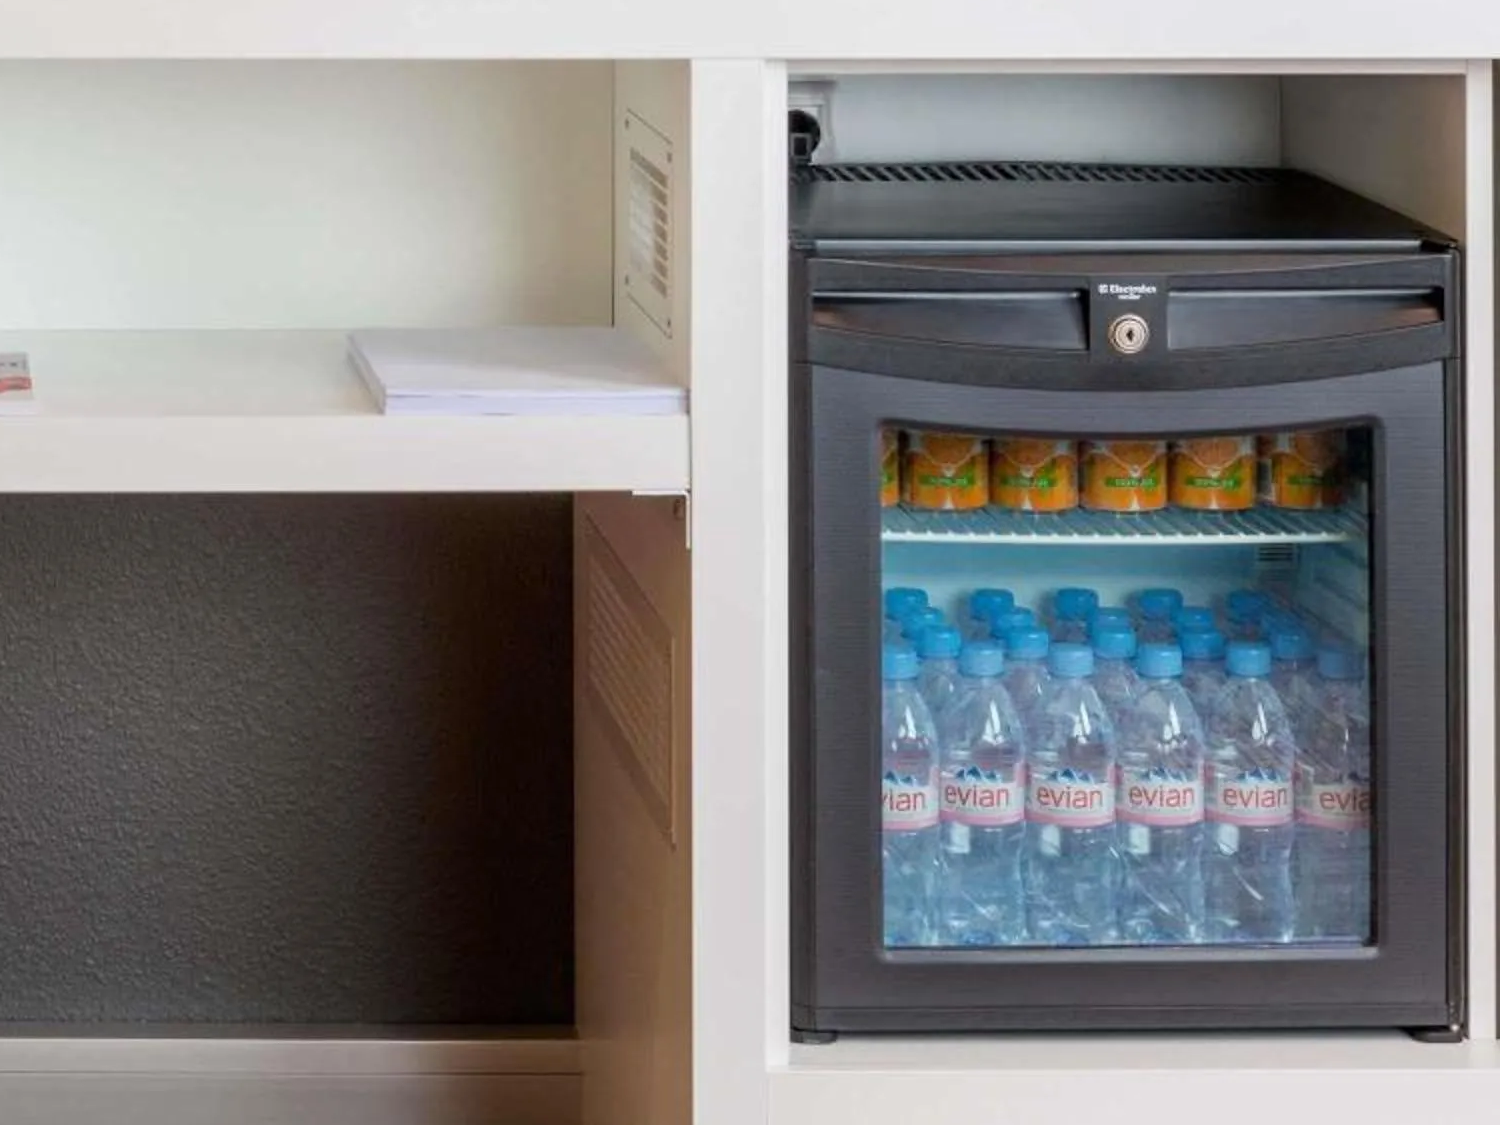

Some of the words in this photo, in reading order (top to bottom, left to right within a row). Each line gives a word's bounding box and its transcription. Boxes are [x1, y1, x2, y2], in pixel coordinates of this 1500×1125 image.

[944, 784, 1010, 808] evian
[1036, 784, 1104, 809] evian
[1127, 784, 1195, 808] evian
[1222, 785, 1288, 809] evian
[1318, 788, 1370, 813] evia
